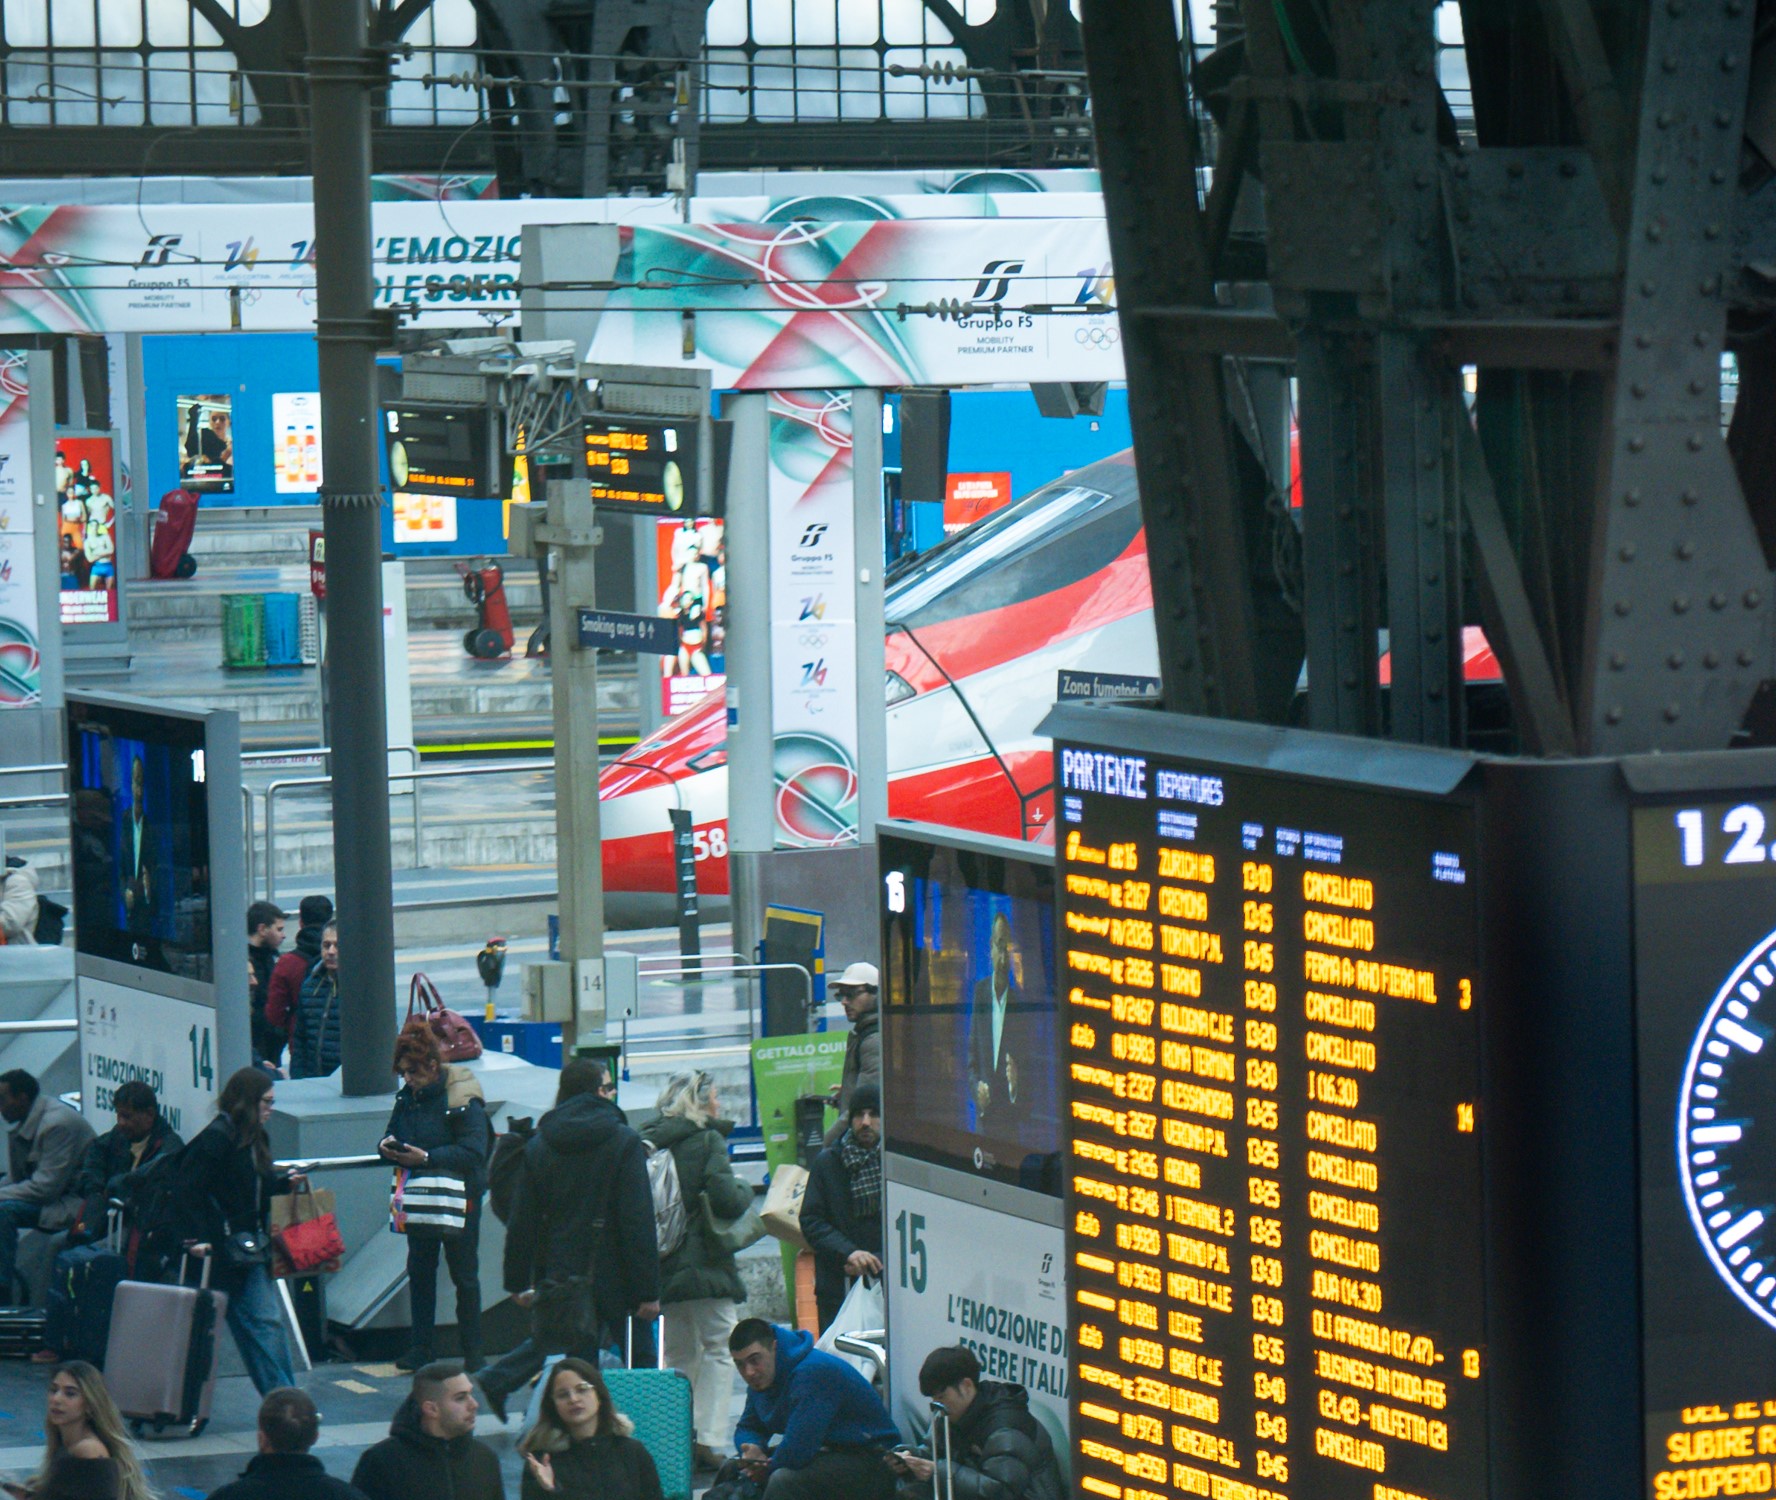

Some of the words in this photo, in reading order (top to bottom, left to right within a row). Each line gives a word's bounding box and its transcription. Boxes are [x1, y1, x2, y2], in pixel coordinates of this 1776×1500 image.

[958, 317, 1013, 331] Gruppo
[1018, 316, 1033, 328] FS
[958, 346, 995, 354] PREMIUM
[582, 615, 616, 639] Smoking
[617, 623, 635, 636] area
[1063, 676, 1090, 695] Zona
[1093, 677, 1140, 699] fumatori
[1062, 749, 1147, 799] PARTENZE
[1156, 769, 1224, 806] DEPARTURES
[1158, 847, 1198, 881] ZURICH
[1303, 871, 1373, 911] CANCELLATO
[1159, 885, 1208, 922] CREMONA
[1304, 910, 1374, 952] CANCELLATO
[583, 976, 601, 991] 14
[1160, 924, 1200, 960] TORINO
[1305, 950, 1341, 986] FERMA
[1355, 959, 1381, 993] RHO
[1380, 964, 1416, 999] FIERA
[1415, 970, 1437, 1004] MIL
[1459, 978, 1472, 1010] 3
[1160, 963, 1201, 998] TIRANO
[1305, 991, 1375, 1032] CANCELLATO
[189, 1023, 213, 1092] 14
[756, 1043, 816, 1059] GETTALO
[1160, 1002, 1209, 1038] BOLOGNA
[1306, 1031, 1375, 1072] CANCELLATO
[88, 1053, 150, 1084] L'EMOZIONE
[151, 1070, 164, 1095] DI
[1161, 1040, 1192, 1073] ROMA
[1191, 1046, 1235, 1083] TERMINI
[1316, 1072, 1358, 1109] (16.30)
[1457, 1103, 1474, 1132] 14
[1162, 1079, 1233, 1120] ALESSANDRIA
[1306, 1110, 1376, 1153] CANCELLATO
[1162, 1118, 1205, 1152] VERONA
[1307, 1150, 1377, 1192] CANCELLATO
[1163, 1156, 1201, 1190] ARONA
[1308, 1190, 1379, 1233] CANCELLATO
[895, 1209, 928, 1294] 15
[1166, 1233, 1207, 1268] TORINO
[1173, 1196, 1225, 1234] TERMINAL
[1223, 1208, 1235, 1237] 2
[1310, 1229, 1379, 1273] CANCELLATO
[948, 1294, 1047, 1351] L'EMOZIONE
[1167, 1272, 1207, 1306] NAPOLI
[1334, 1314, 1391, 1355] AFRAGOLA
[1462, 1349, 1480, 1379] 13
[1168, 1310, 1204, 1343] LECCE
[1318, 1350, 1375, 1390] BUSINESS
[1374, 1365, 1392, 1395] IN
[1169, 1347, 1199, 1380] BARI
[1369, 1403, 1429, 1445] MOLFETTA
[1169, 1386, 1219, 1424] LOCARNO
[1316, 1427, 1385, 1473] CANCELLATO
[1172, 1425, 1219, 1462] VENEZIA
[1666, 1426, 1755, 1463] SUBIRE
[1173, 1462, 1210, 1497] PORTO
[1653, 1462, 1772, 1500] SCIOPERO
